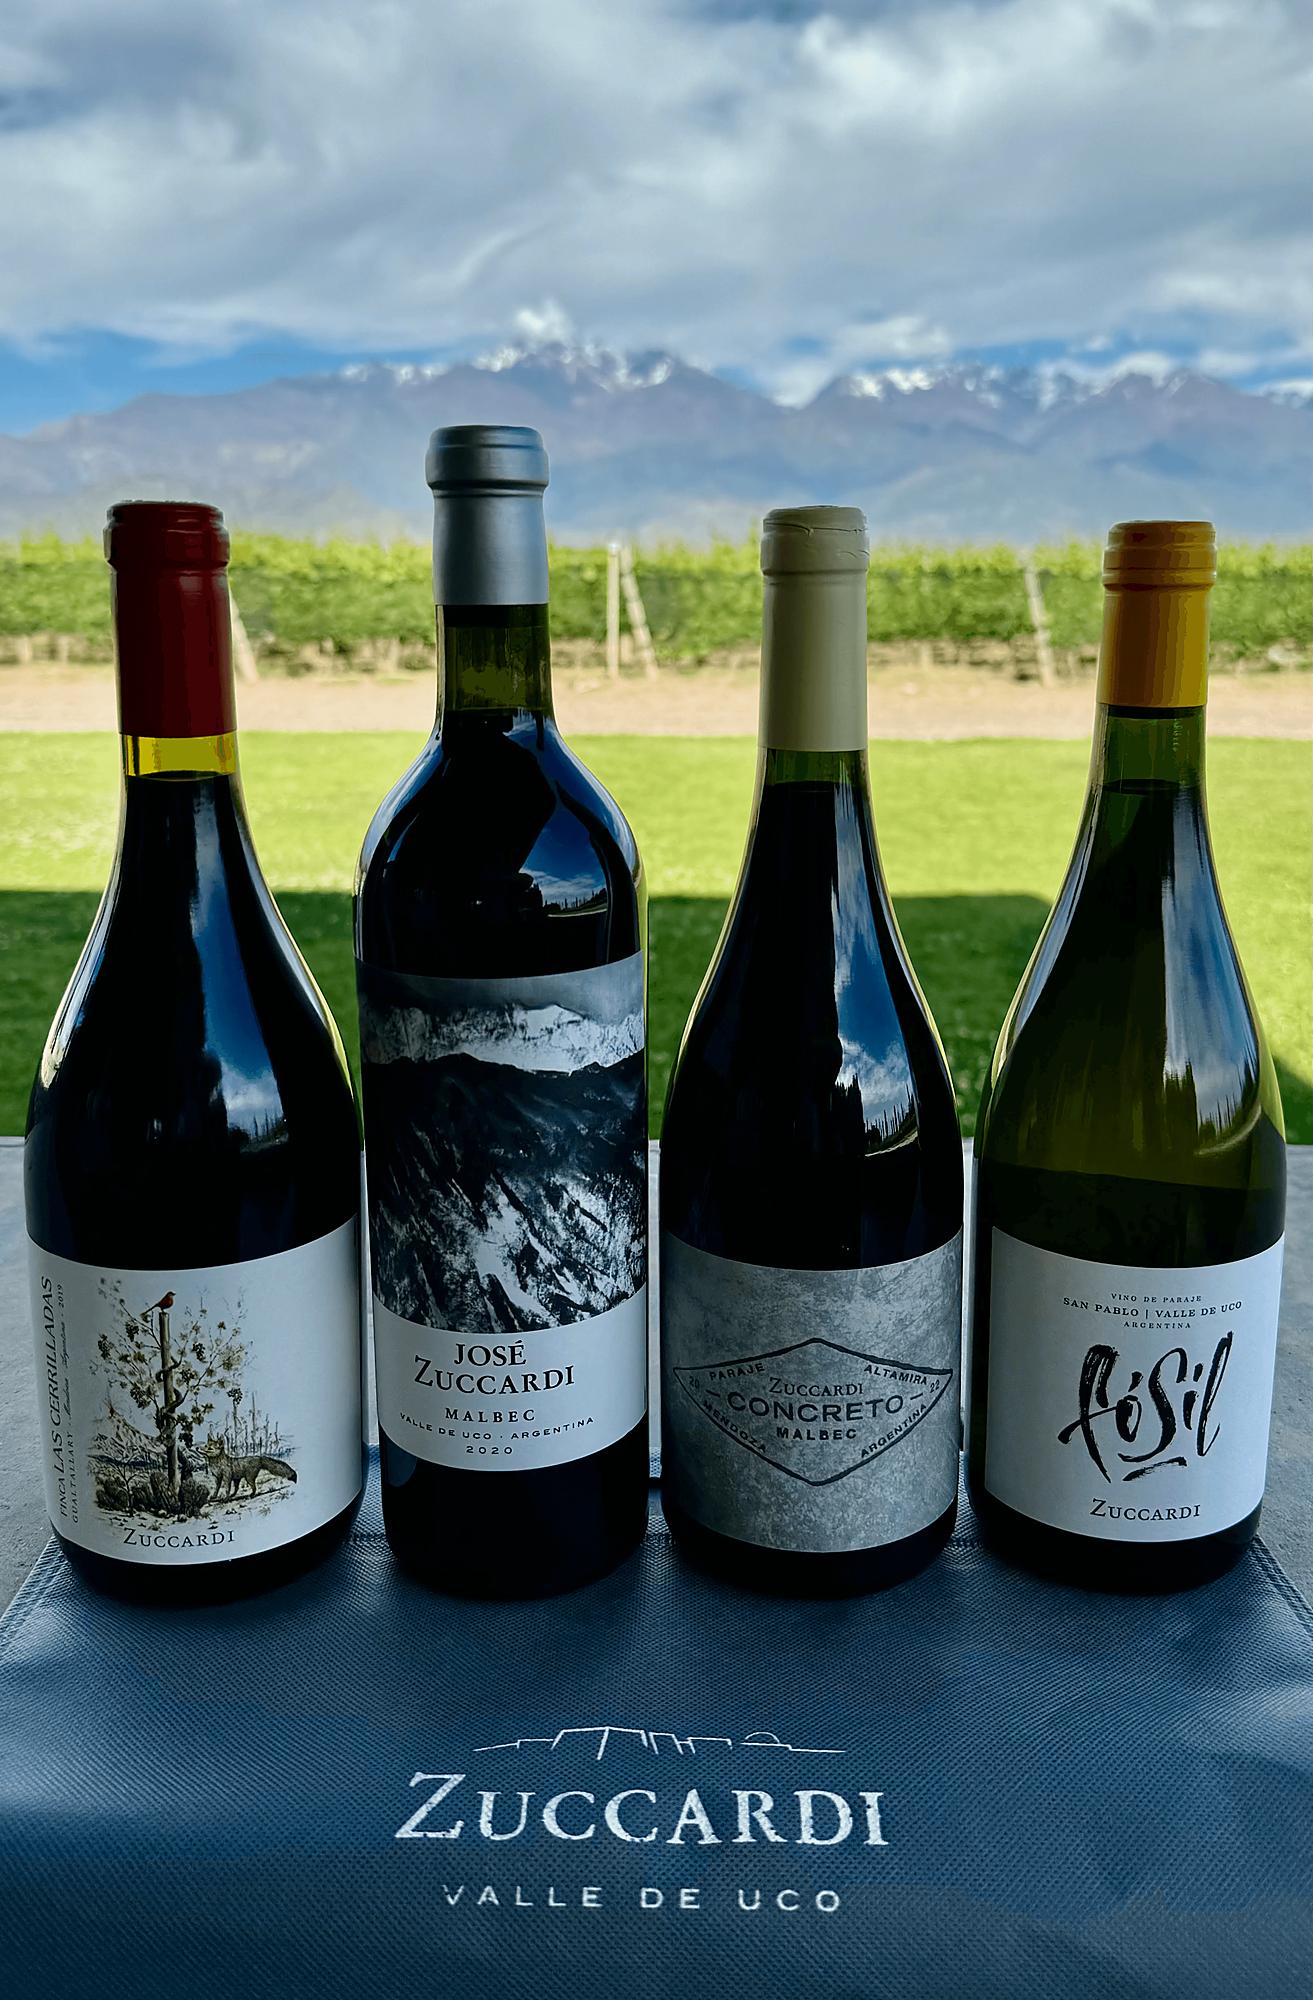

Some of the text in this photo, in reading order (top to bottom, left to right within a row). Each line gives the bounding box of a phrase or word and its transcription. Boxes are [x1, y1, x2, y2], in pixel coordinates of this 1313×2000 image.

[1063, 1297, 1243, 1318] SAN PABLO VALLE DE UCO
[1111, 1293, 1137, 1302] VINO
[1163, 1295, 1202, 1303] PARAJE
[454, 1340, 527, 1366] JOSÉ
[414, 1355, 575, 1394] ZUCCARDI
[709, 1363, 928, 1385] PARAJE ALTAMIRA
[41, 1276, 68, 1517] FINCA LAS CERRILLADAS
[688, 1376, 940, 1397] 20 ZUCCARDI 22
[445, 1408, 536, 1423] MALBEC
[727, 1391, 904, 1422] CONCRETO
[400, 1412, 594, 1440] VALLE DE UCO ARGENTINA
[702, 1400, 927, 1458] MENDOZA ARGENTINA
[777, 1427, 857, 1441] MALBEC
[466, 1445, 514, 1454] 2020
[67, 1431, 79, 1523] GUALTALLARY
[1090, 1499, 1201, 1521] ZUCCARDI
[123, 1528, 235, 1548] ZUCCARDI
[394, 1771, 890, 1847] ZUCCARDI
[442, 1884, 843, 1913] VALLE DE UCO
